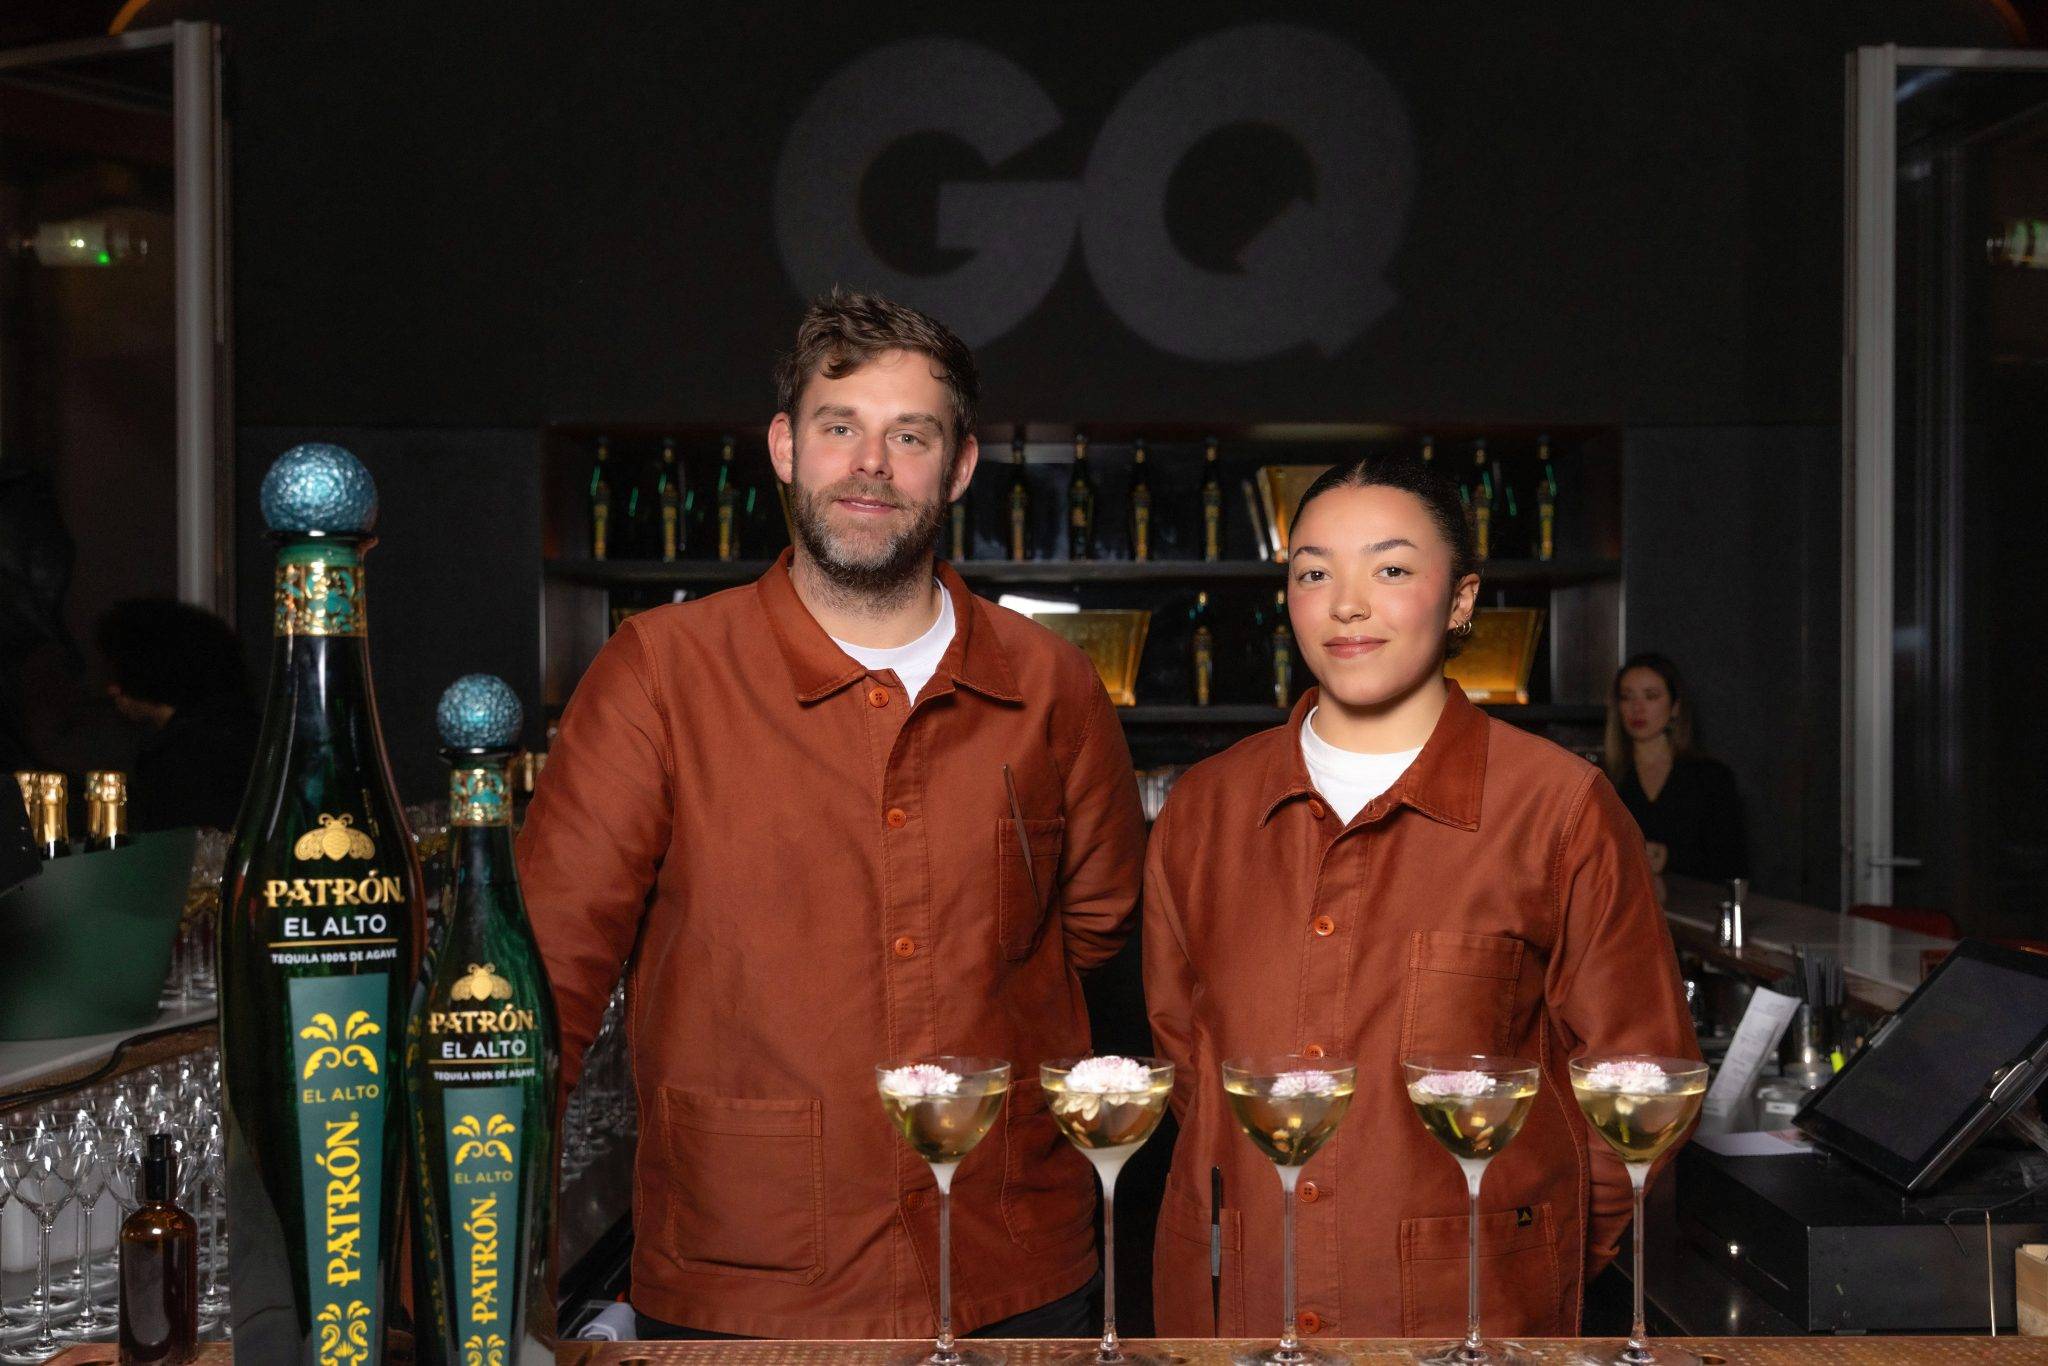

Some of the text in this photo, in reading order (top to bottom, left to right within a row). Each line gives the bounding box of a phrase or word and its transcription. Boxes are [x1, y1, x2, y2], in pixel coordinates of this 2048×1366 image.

[775, 22, 1417, 362] GQ
[263, 869, 404, 907] PATRÓN
[284, 914, 387, 937] EL ALTO
[271, 949, 397, 964] TEQUILA 100% DE AGAVE
[428, 1003, 534, 1034] PATRÓN
[442, 1039, 527, 1058] EL ALTO
[433, 1071, 470, 1081] TEQUILA
[495, 1070, 507, 1080] DE
[303, 1083, 380, 1104] EL ALTO
[455, 1170, 513, 1185] EL ALTO
[315, 1120, 361, 1288] PATRÓN
[463, 1198, 498, 1324] PATRÓN
